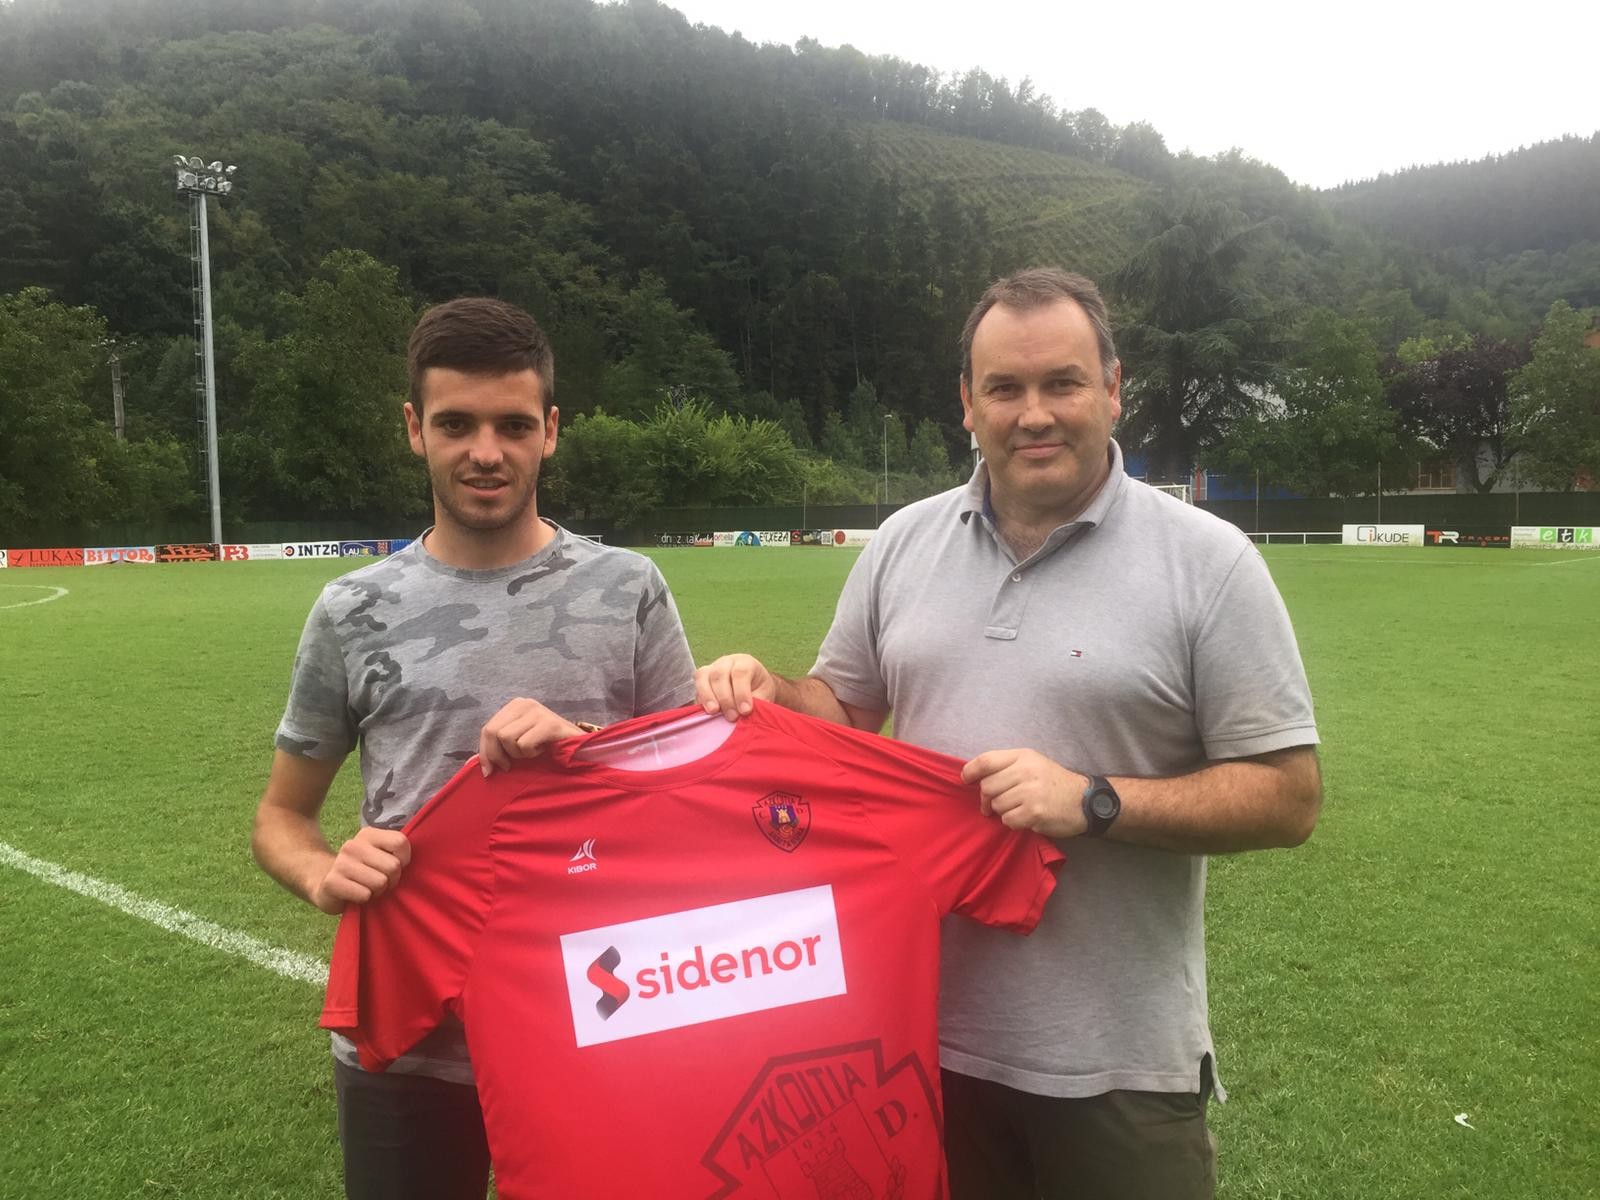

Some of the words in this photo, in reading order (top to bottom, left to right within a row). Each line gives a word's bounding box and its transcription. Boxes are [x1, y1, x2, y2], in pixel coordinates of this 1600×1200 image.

[29, 549, 84, 562] LUKAS
[223, 546, 249, 561] P3
[298, 544, 338, 557] INTZA
[567, 863, 598, 875] KIBOR
[636, 934, 821, 999] sidenor
[736, 1061, 867, 1171] AZKOITIA
